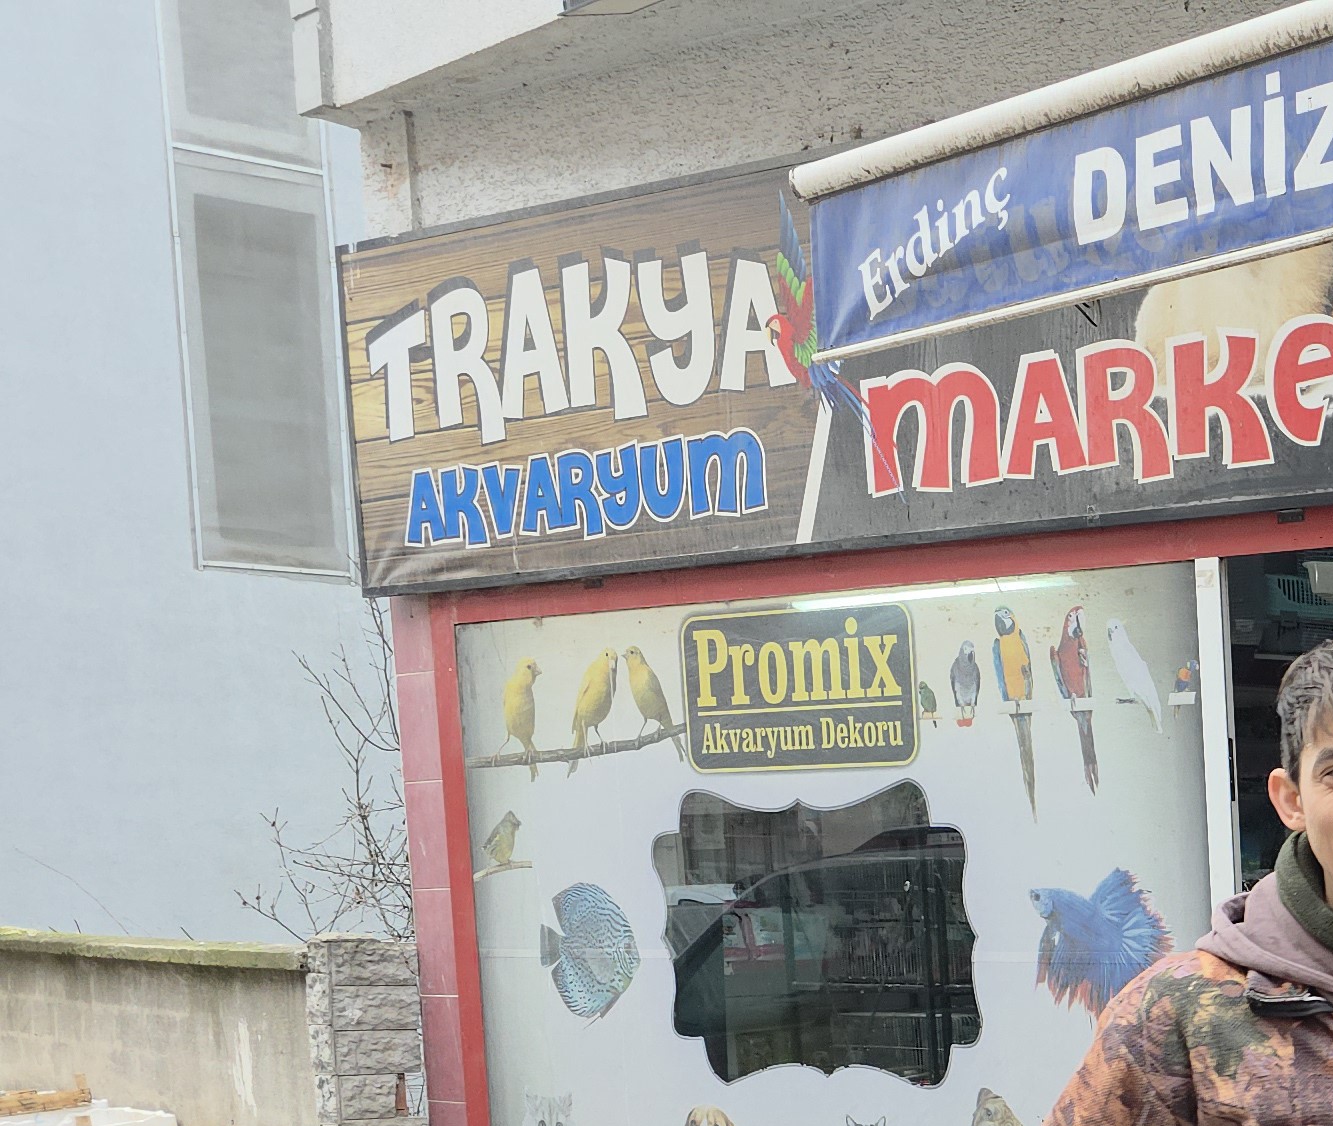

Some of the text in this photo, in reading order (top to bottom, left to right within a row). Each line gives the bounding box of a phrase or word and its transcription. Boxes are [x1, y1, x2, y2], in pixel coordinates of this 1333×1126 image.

[858, 164, 1012, 321] Erdinç
[367, 248, 797, 446] TRAKYA
[692, 616, 903, 708] Promix
[701, 716, 904, 759] Akvaryum Dekoru
